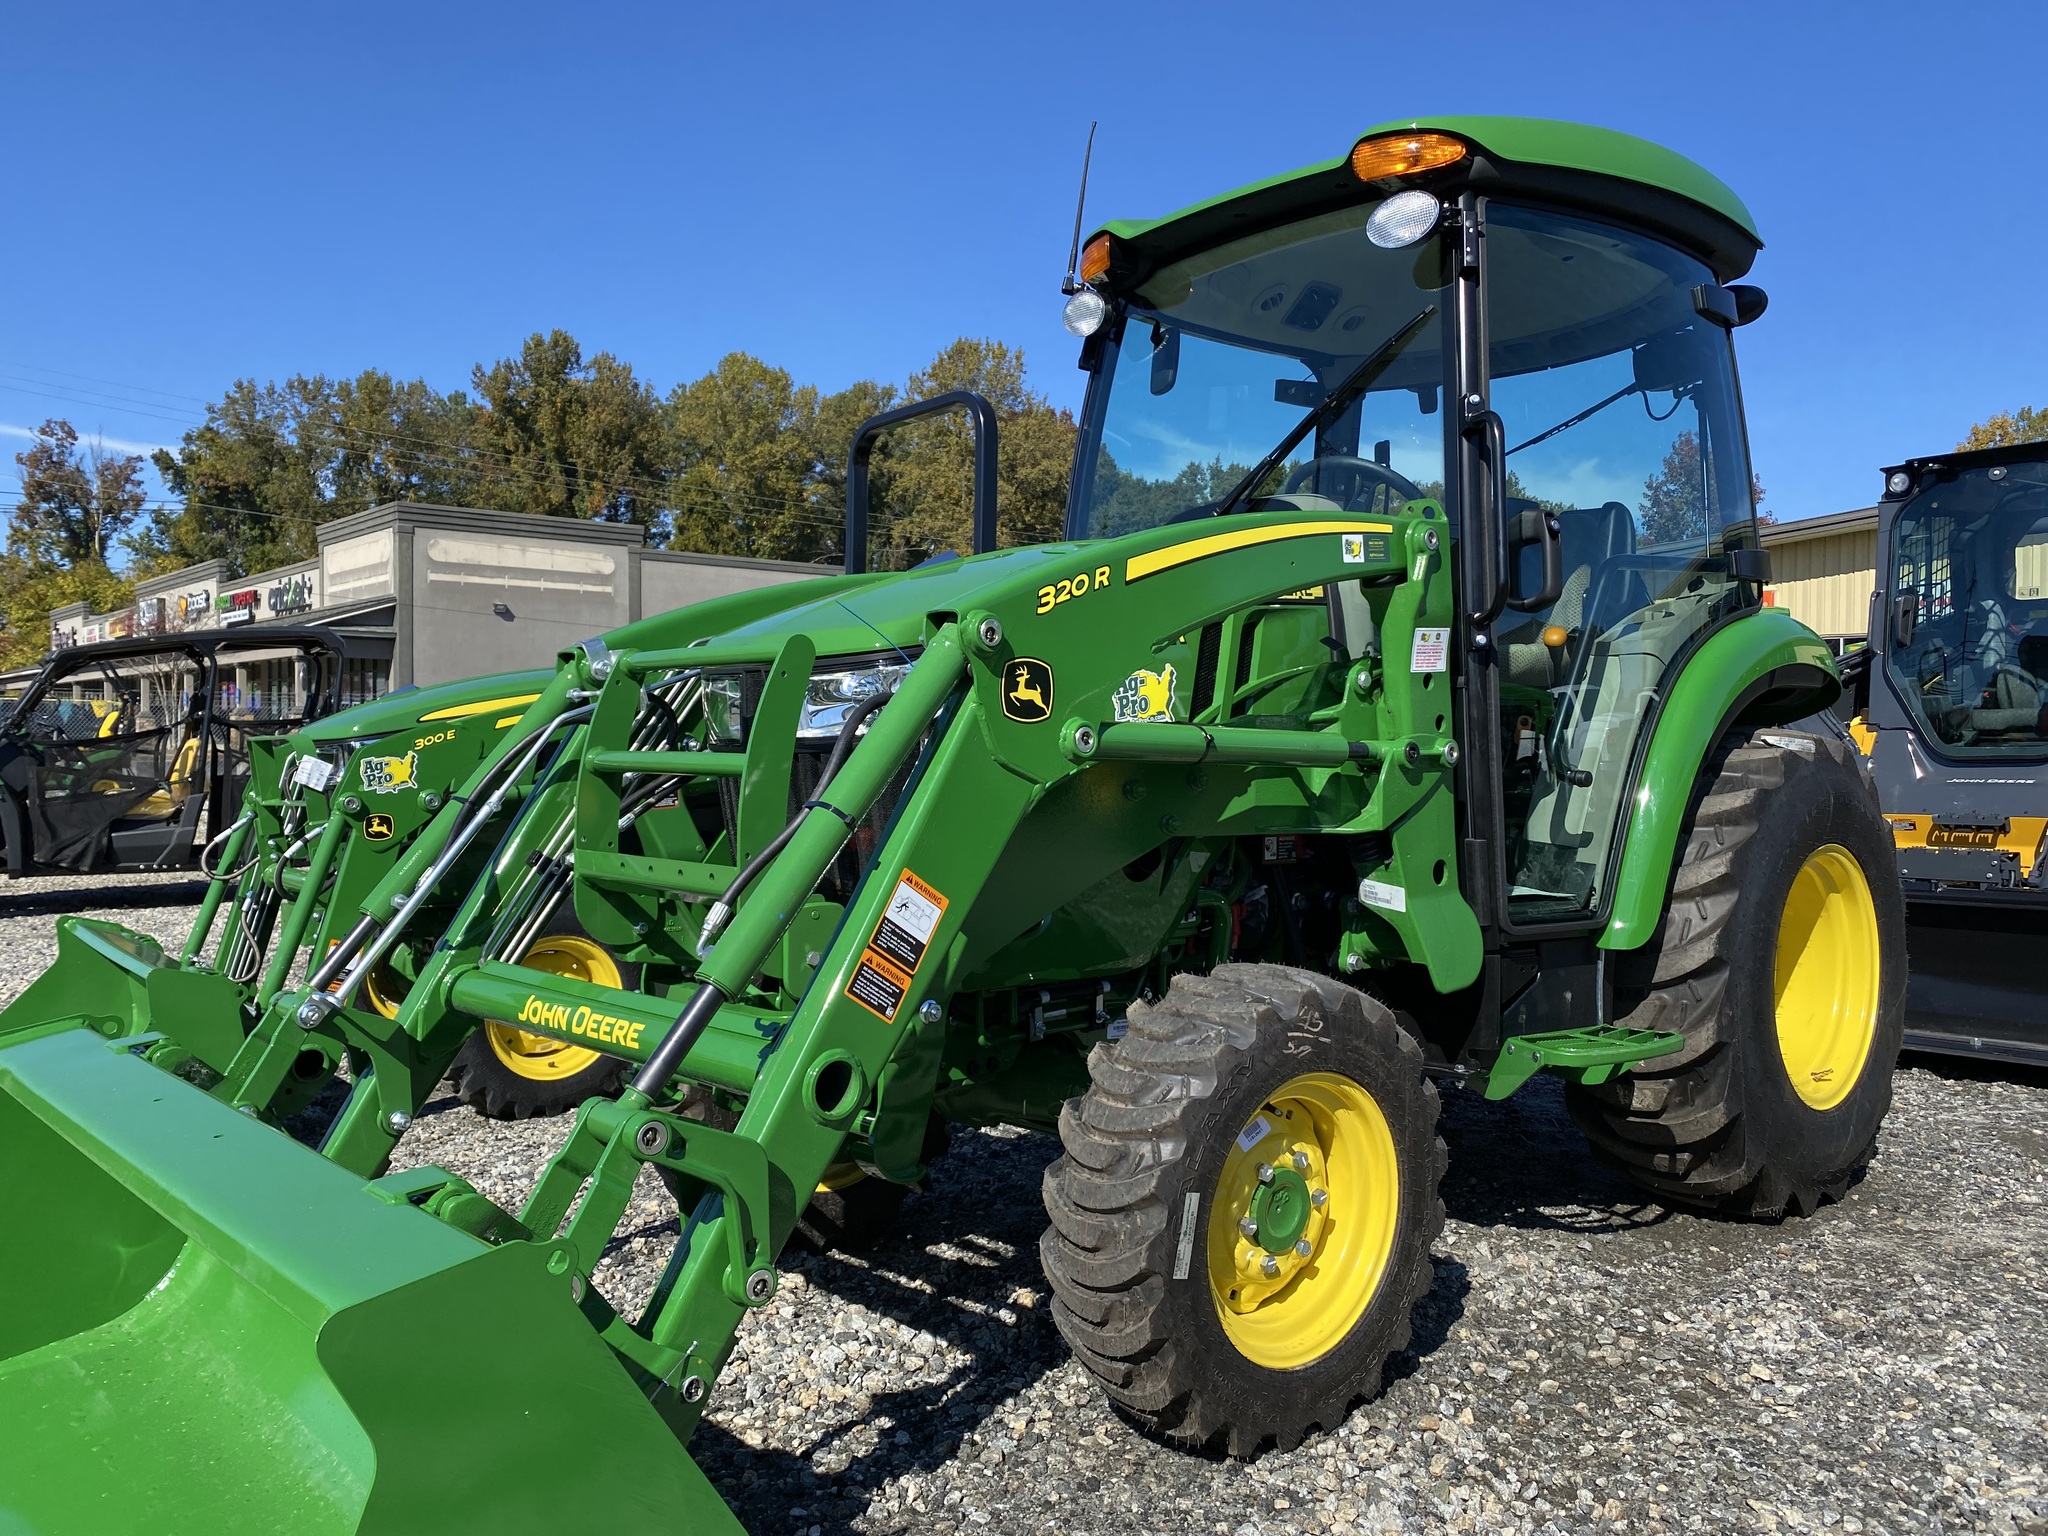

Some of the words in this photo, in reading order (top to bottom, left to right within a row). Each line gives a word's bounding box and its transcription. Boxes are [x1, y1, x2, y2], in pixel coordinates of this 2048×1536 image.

[188, 590, 208, 611] boost
[268, 575, 312, 611] cricket
[1036, 573, 1090, 615] 320
[1093, 564, 1110, 590] R
[1118, 695, 1149, 718] Pro
[414, 732, 444, 750] 300
[446, 729, 456, 740] E
[363, 760, 390, 775] Ag-
[365, 773, 393, 788] Pro
[913, 879, 943, 905] WARNING
[875, 961, 905, 986] WARNING
[518, 994, 571, 1031] JOHN
[571, 1005, 646, 1049] DEERE
